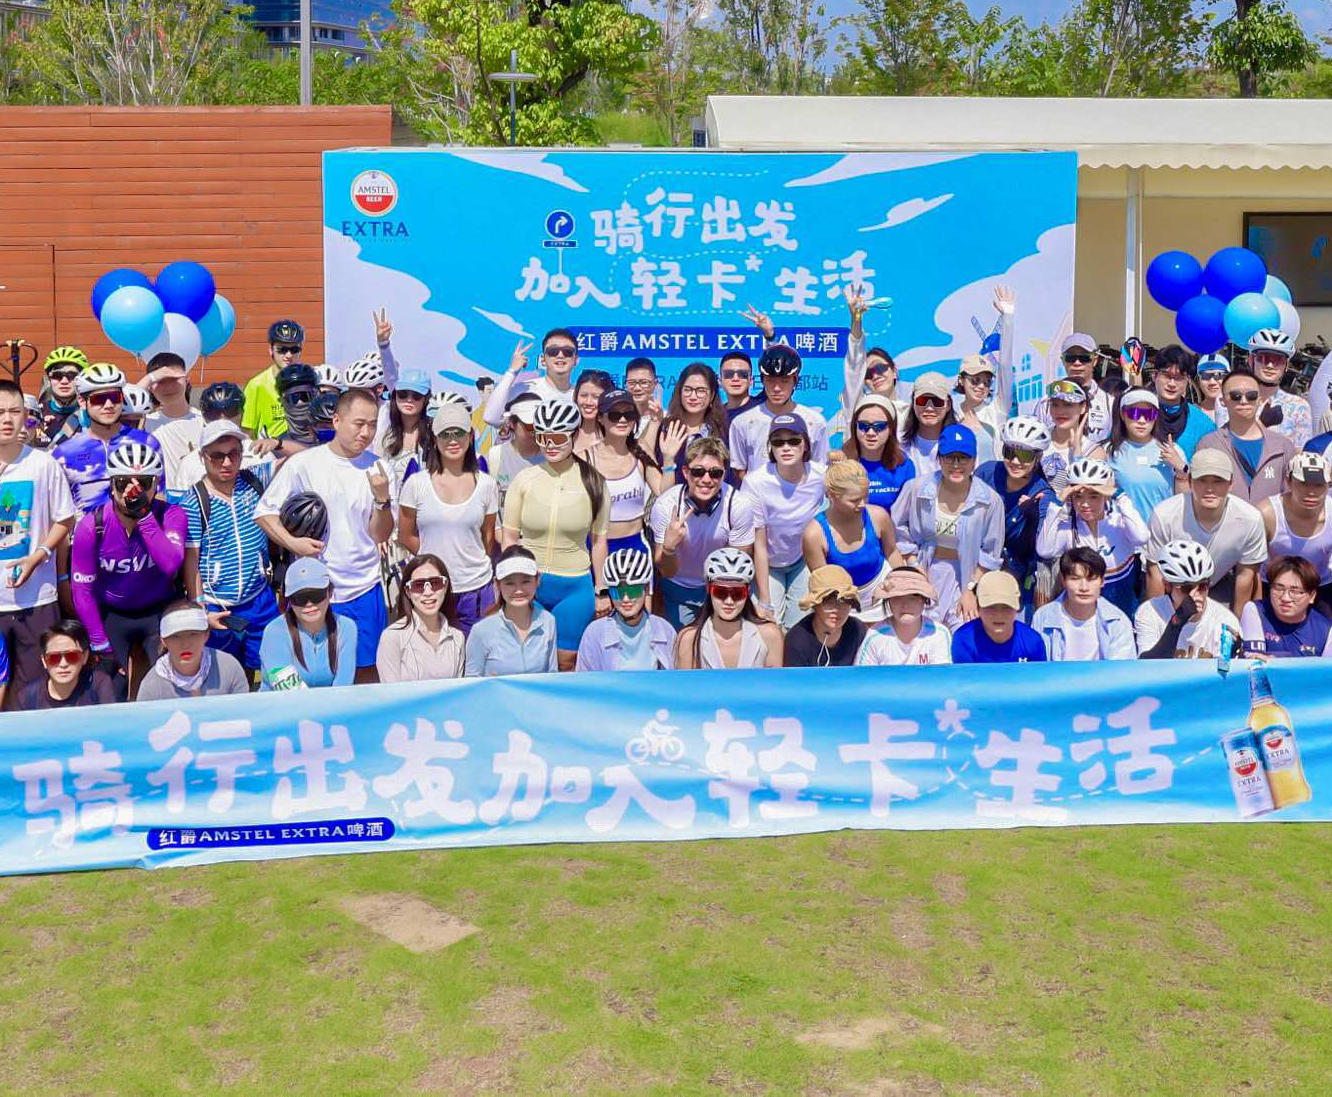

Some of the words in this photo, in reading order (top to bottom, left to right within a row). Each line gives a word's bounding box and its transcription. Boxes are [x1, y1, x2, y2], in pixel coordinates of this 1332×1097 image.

[358, 186, 391, 195] AMSTEL
[365, 195, 382, 203] BEER
[342, 221, 409, 238] EXTRA
[590, 187, 798, 255] 骑行出发
[717, 332, 838, 352] EXTA啤酒
[99, 555, 156, 574] NSV
[281, 821, 384, 839] EXTRA啤酒
